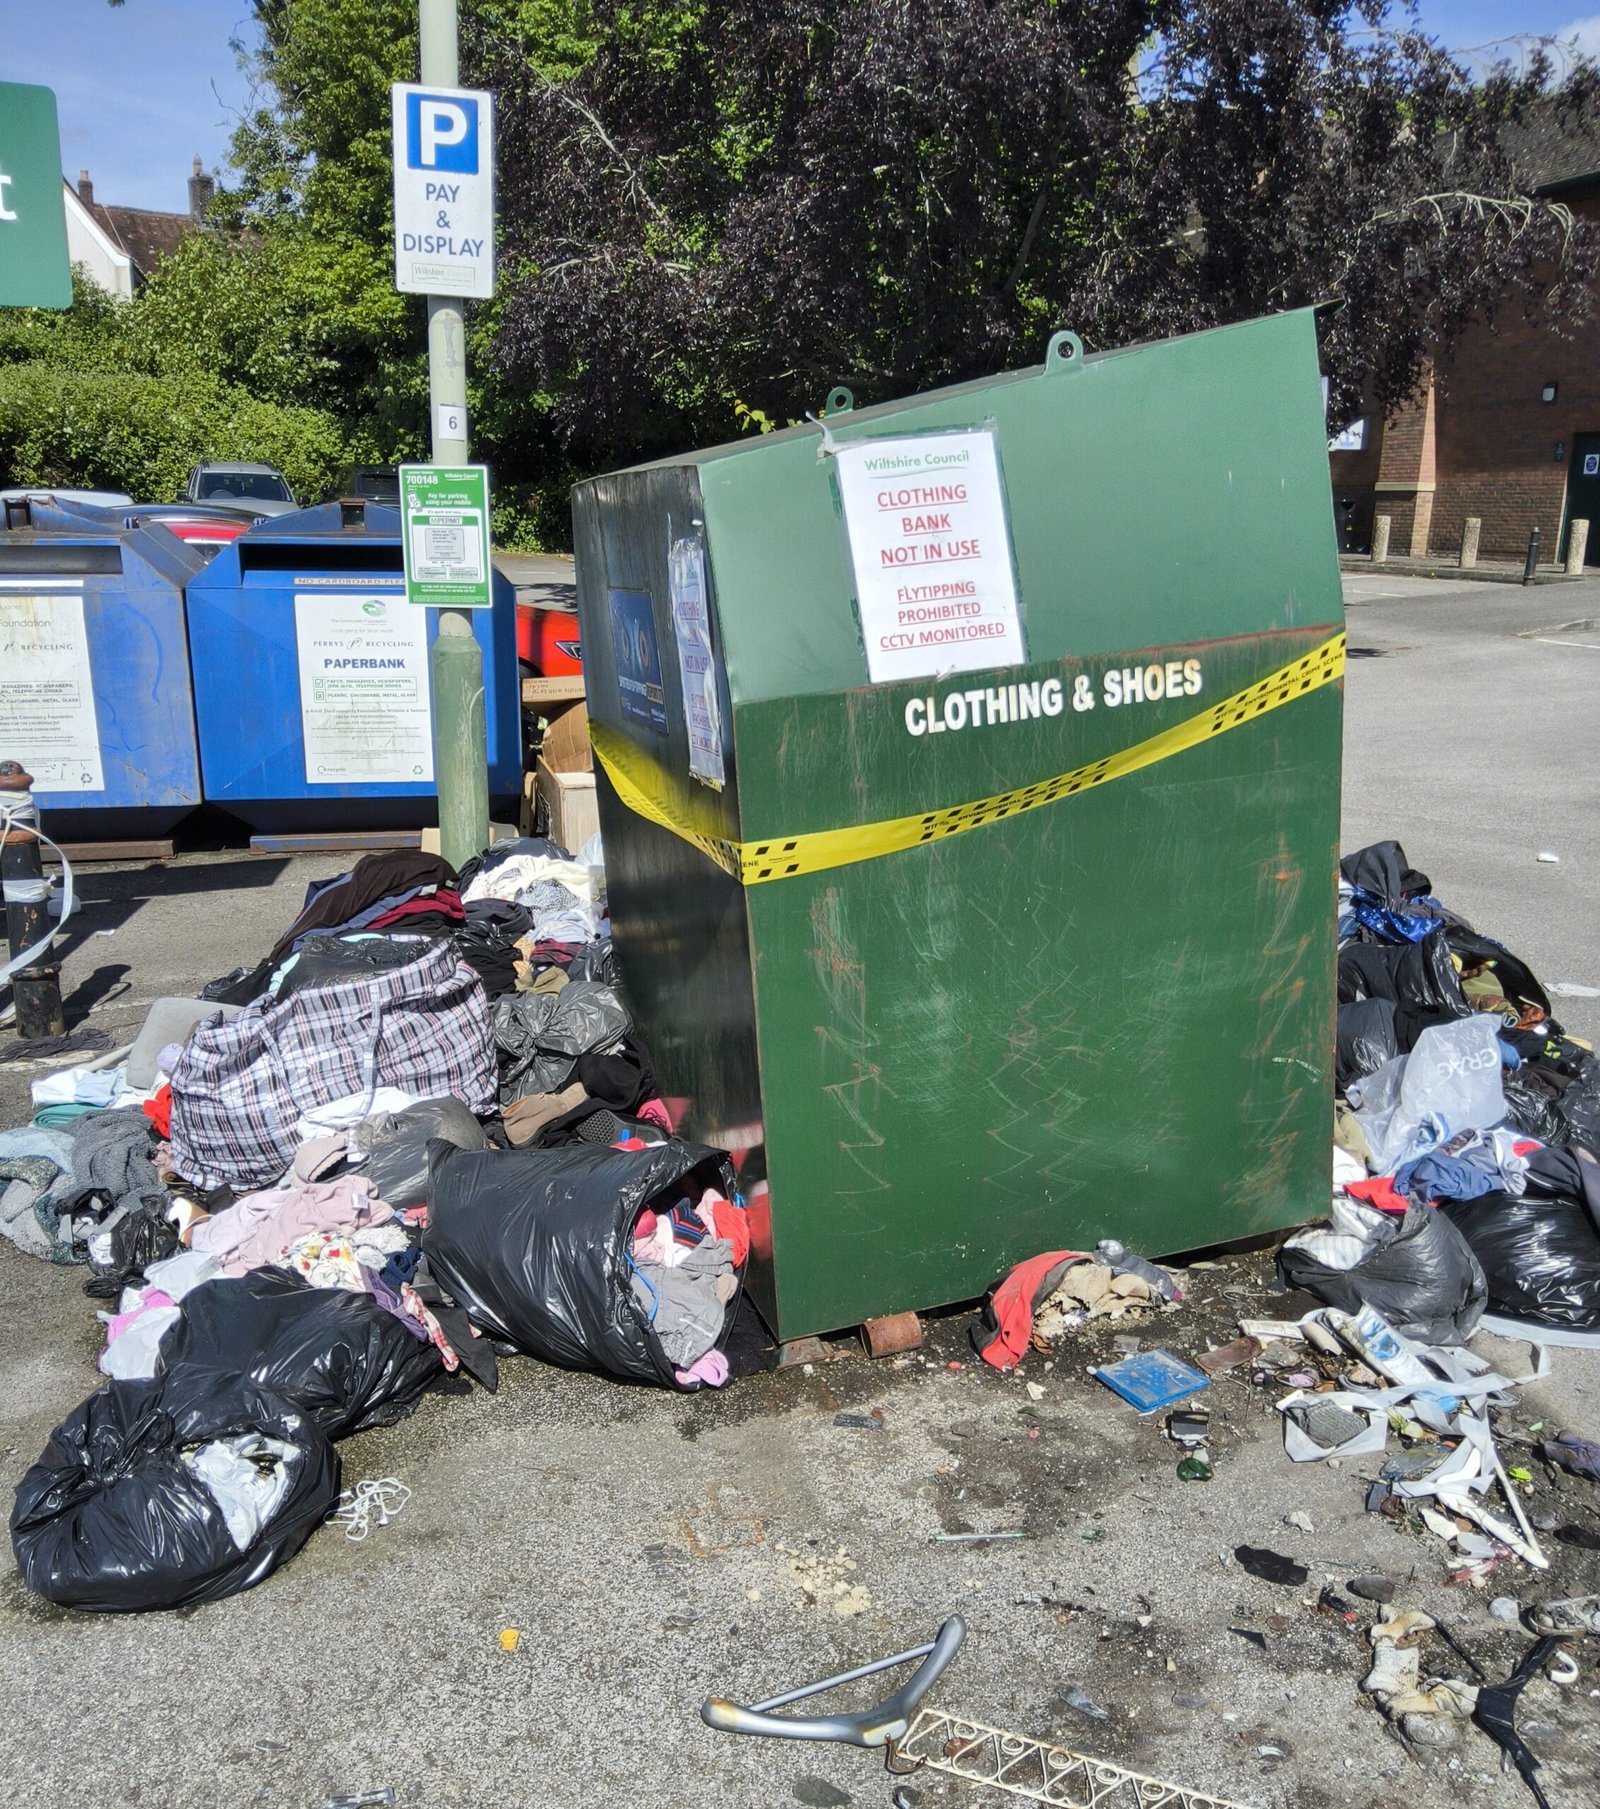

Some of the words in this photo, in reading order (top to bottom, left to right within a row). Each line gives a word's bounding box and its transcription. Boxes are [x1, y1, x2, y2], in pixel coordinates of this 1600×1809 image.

[420, 99, 467, 166] P
[425, 183, 460, 203] PAY
[436, 210, 451, 229] &
[403, 233, 484, 258] DISPLAY
[414, 266, 445, 276] Wiltshire
[448, 416, 457, 430] 6
[864, 455, 921, 471] Wiltshire
[925, 450, 970, 466] Council
[405, 475, 439, 485] 700148
[877, 484, 967, 508] CLOTHING
[902, 513, 952, 533] BANK
[880, 547, 918, 565] NOT
[924, 543, 942, 560] IN
[947, 539, 980, 556] USE
[897, 581, 976, 602] FLYTIPPING
[898, 602, 981, 623] PROHIBITED
[880, 633, 915, 649] CCTV
[919, 622, 1006, 645] MONITORED
[324, 658, 406, 669] PAPERBANK
[1244, 677, 1300, 707] ENVIRONMENTAL
[1301, 665, 1321, 679] CRIME
[1323, 652, 1343, 667] SCENE
[905, 678, 1064, 737] CLOTHING
[1072, 674, 1096, 712] &
[1103, 658, 1203, 708] SHOES
[957, 799, 1021, 822] ENVIRONMENTAL
[741, 860, 760, 868] ENE
